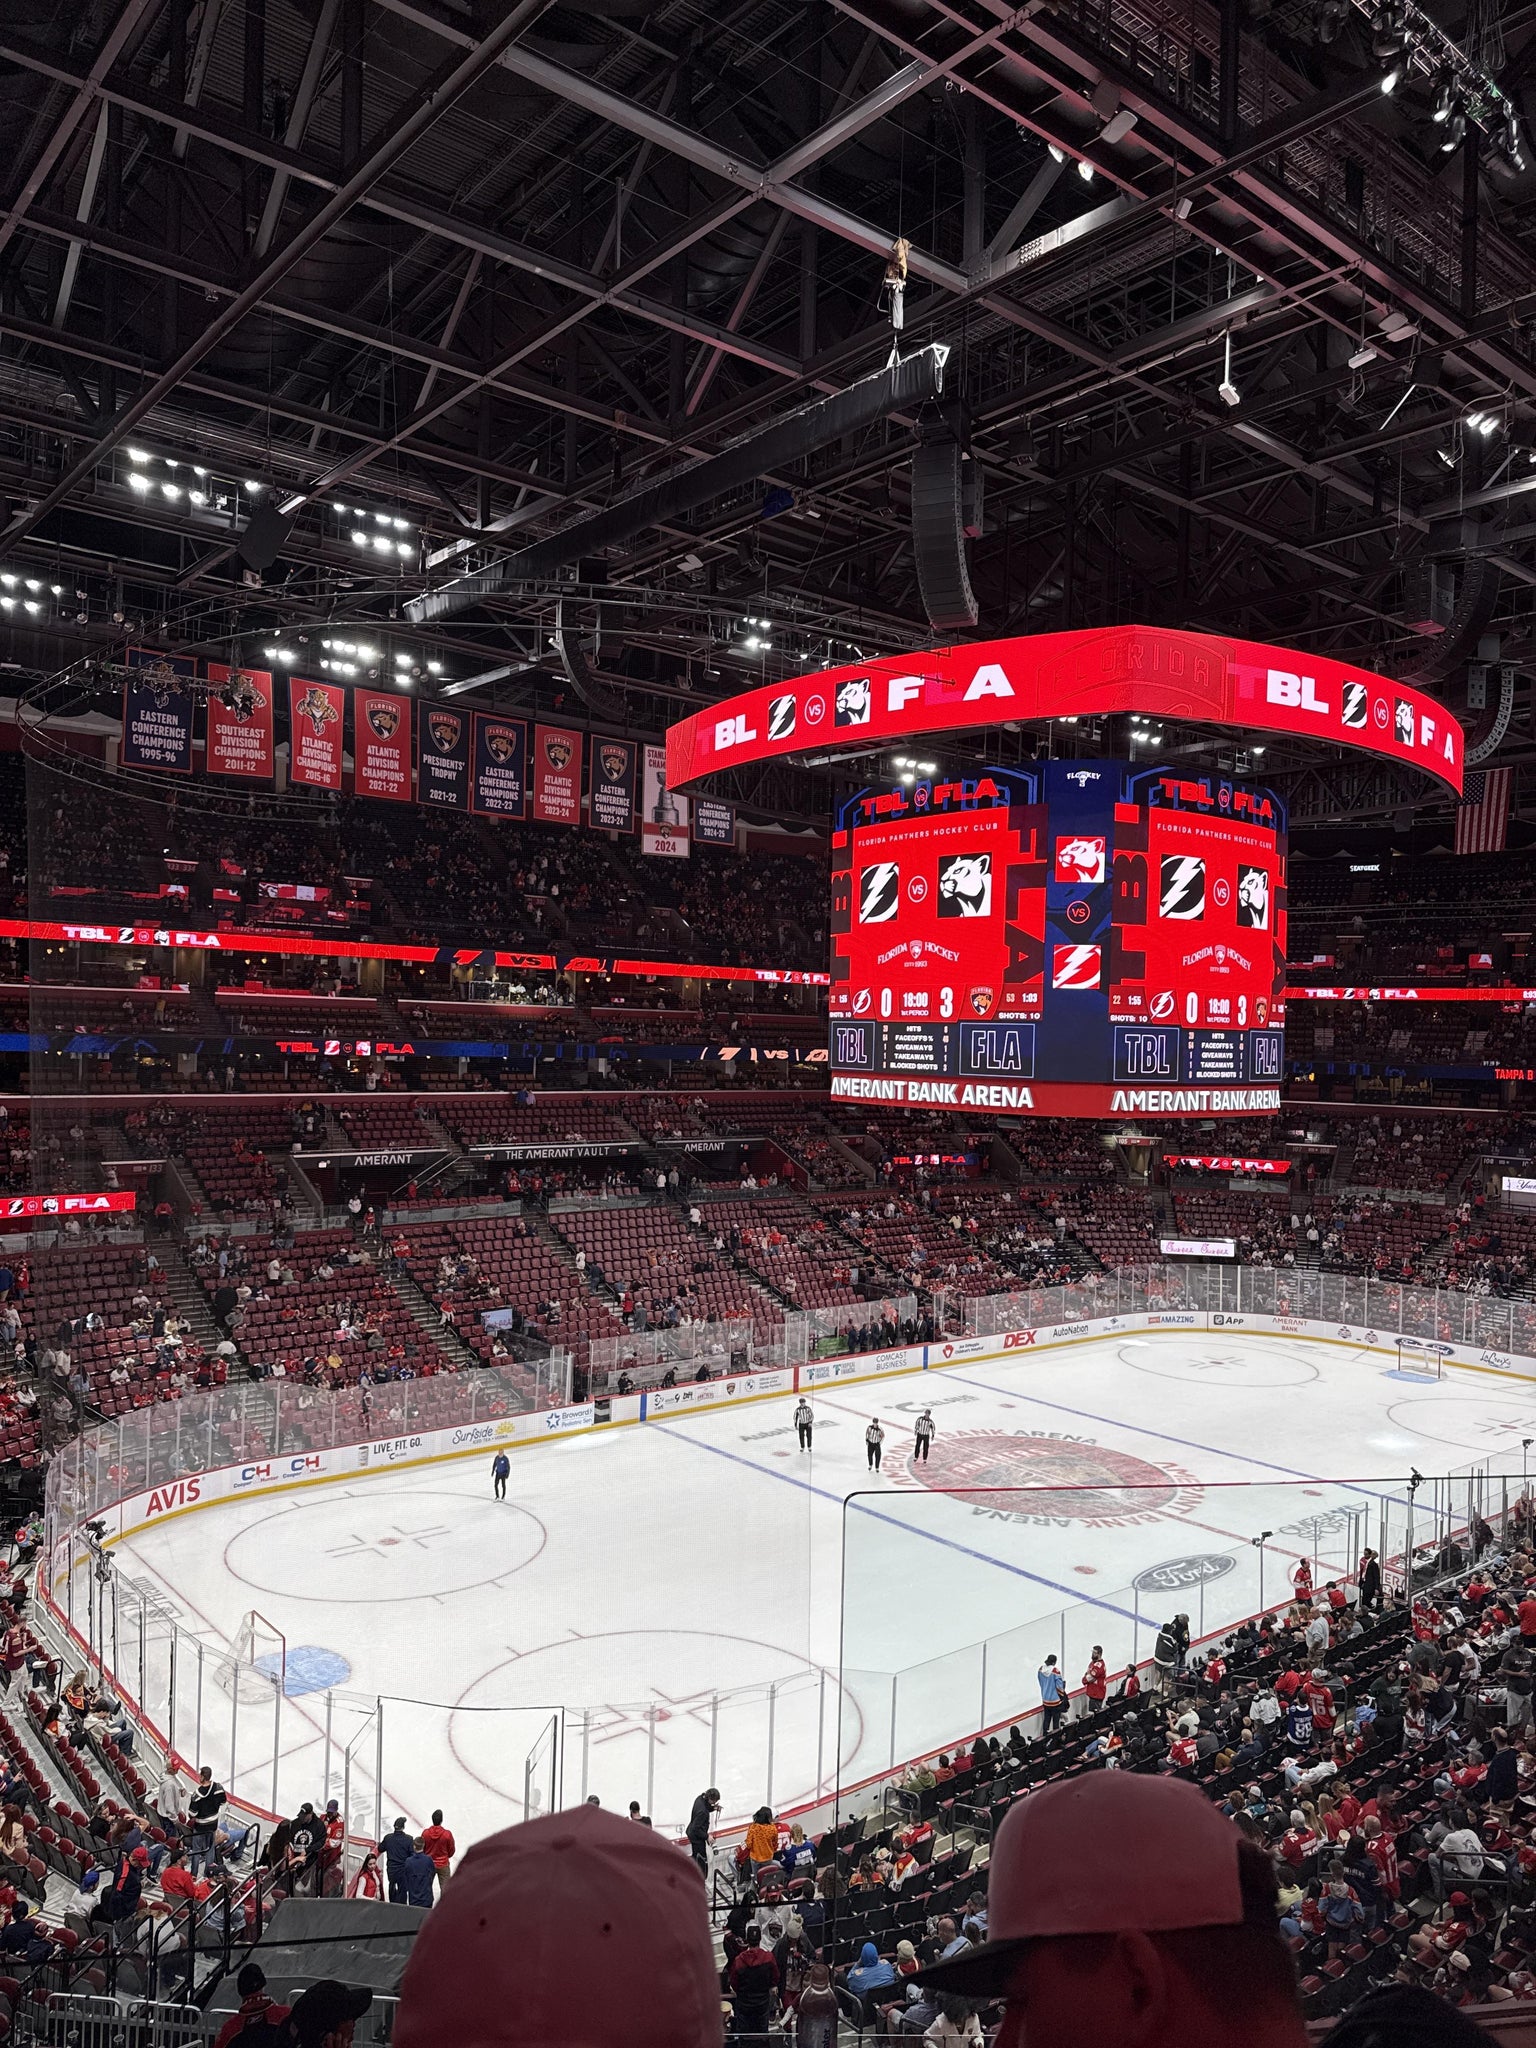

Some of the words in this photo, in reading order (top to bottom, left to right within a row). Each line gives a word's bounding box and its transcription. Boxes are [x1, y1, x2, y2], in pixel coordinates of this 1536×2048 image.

[808, 704, 821, 716] VS
[1376, 708, 1387, 720] VS
[140, 710, 179, 726] EASTERN
[132, 721, 186, 740] CONFERENCE
[216, 724, 266, 739] SOUTHEAST
[132, 734, 184, 751] CHAMPIONS
[222, 736, 260, 748] DIVISION
[302, 736, 333, 751] ATLANTIC
[140, 748, 176, 763] 1995-96
[214, 746, 266, 761] CHAMPIONS
[302, 747, 332, 762] DIVISION
[367, 745, 400, 758] ATLANTIC
[225, 759, 256, 772] 2011-12
[297, 756, 337, 773] CHAMPIONS
[368, 757, 399, 770] DIVISION
[423, 754, 465, 771] PRESIDENTS'
[306, 770, 331, 784] 2015-16
[362, 767, 405, 782] CHAMPIONS
[431, 768, 457, 781] TROPHY
[486, 766, 514, 779] EASTERN
[369, 780, 398, 792] 2021-22
[479, 776, 520, 791] CONFERENCE
[544, 775, 572, 787] ATLANTIC
[480, 788, 519, 801] CHAMPIONS
[544, 785, 571, 797] DIVISION
[600, 784, 625, 795] EASTERN
[430, 790, 457, 803] 2021-22
[540, 794, 575, 808] CHAMPIONS
[595, 794, 630, 807] CONFERENCE
[860, 793, 909, 816] TBL
[934, 778, 1000, 805] FLA
[1159, 778, 1214, 805] TBL
[1234, 792, 1272, 819] FLA
[485, 798, 513, 810] 2022-23
[596, 804, 629, 817] CHAMPIONS
[544, 806, 570, 817] 2023-24
[698, 809, 730, 820] CONFERENCE
[600, 815, 624, 826] 2023-24
[700, 818, 730, 829] CHAMPIONS
[704, 828, 726, 838] 2024-25
[858, 836, 886, 847] FLORIDA
[890, 830, 930, 842] PANTHERS
[933, 826, 969, 836] HOCKEY
[974, 822, 998, 832] CLUB
[1157, 823, 1192, 834] FLORIDA
[1196, 829, 1231, 841] PANTHERS
[1234, 835, 1258, 846] HOCKEY
[1260, 839, 1272, 850] CLUB
[655, 840, 676, 852] 2024
[911, 884, 924, 895] VS
[1217, 887, 1227, 897] VS
[1072, 908, 1086, 917] VS
[63, 926, 111, 940] TBL
[176, 934, 221, 947] FLA
[878, 942, 908, 964] FLORIDA
[924, 942, 960, 962] HOCKEY
[1182, 946, 1213, 967] FLORIDA
[1227, 948, 1252, 971] HOCKEY
[756, 970, 781, 981] TBL
[904, 992, 929, 1008] 18:00
[1006, 994, 1016, 1003] 53
[1022, 993, 1038, 1003] 1:03
[1112, 995, 1121, 1005] 22
[1128, 995, 1142, 1005] 1:55
[1305, 989, 1338, 998] TBL
[1384, 990, 1418, 998] FLA
[881, 988, 892, 1018] 0
[940, 987, 954, 1018] 3
[1186, 992, 1198, 1023] 0
[1208, 998, 1230, 1015] 18:00
[909, 1009, 929, 1017] PERIOD
[998, 1012, 1027, 1020] SHOTS:
[1030, 1012, 1041, 1020] 10
[1238, 995, 1247, 1026] 3
[1110, 1014, 1136, 1022] SHOTS:
[895, 1034, 928, 1042] FACEOFFS
[276, 1042, 319, 1053] TBL
[376, 1042, 416, 1055] FLA
[837, 1028, 867, 1063] TBL
[971, 1030, 1022, 1070] FLA
[764, 1050, 789, 1061] VS
[894, 1053, 934, 1061] TAKEAWAYS
[1125, 1034, 1170, 1074] TBL
[1255, 1038, 1278, 1074] FLA
[890, 1062, 917, 1070] BLOCKED
[916, 1063, 939, 1071] SHOTS
[1495, 1068, 1524, 1080] TAMPA
[830, 1077, 908, 1099] AMERANT
[908, 1082, 959, 1103] BANK
[961, 1084, 1034, 1108] ARENA
[1111, 1090, 1210, 1112] AMERANT
[1211, 1090, 1249, 1111] BANK
[1249, 1089, 1281, 1110] ARENA
[506, 1148, 522, 1160] THE
[526, 1148, 575, 1159] AMERANT
[578, 1146, 610, 1157] VAULT
[684, 1142, 725, 1152] AMERANT
[354, 1154, 413, 1168] AMERANT
[942, 1155, 966, 1164] FLA
[64, 1197, 110, 1210] FLA
[1161, 1316, 1195, 1324] AMAZING
[1272, 1318, 1308, 1327] AMERANT
[1052, 1324, 1089, 1338] AutoNation
[1004, 1330, 1038, 1349] DEX
[876, 1352, 908, 1363] COMCAST
[876, 1360, 908, 1371] BUSINESS
[562, 1409, 590, 1420] Broward
[452, 1425, 493, 1446] Surfside
[940, 1428, 1003, 1439] BANK
[1014, 1429, 1098, 1447] ARENA
[374, 1441, 393, 1455] LIVE.
[394, 1438, 408, 1452] FIT.
[410, 1437, 423, 1449] GO.
[291, 1456, 320, 1472] CH
[310, 1466, 328, 1474] Hunter
[242, 1464, 271, 1481] CH
[234, 1481, 252, 1489] Cooper
[260, 1475, 279, 1483] Hunter
[146, 1478, 200, 1517] AVIS
[972, 1506, 1071, 1528] ARENA
[1084, 1516, 1166, 1529] BANK
[1153, 1560, 1220, 1588] Ford
